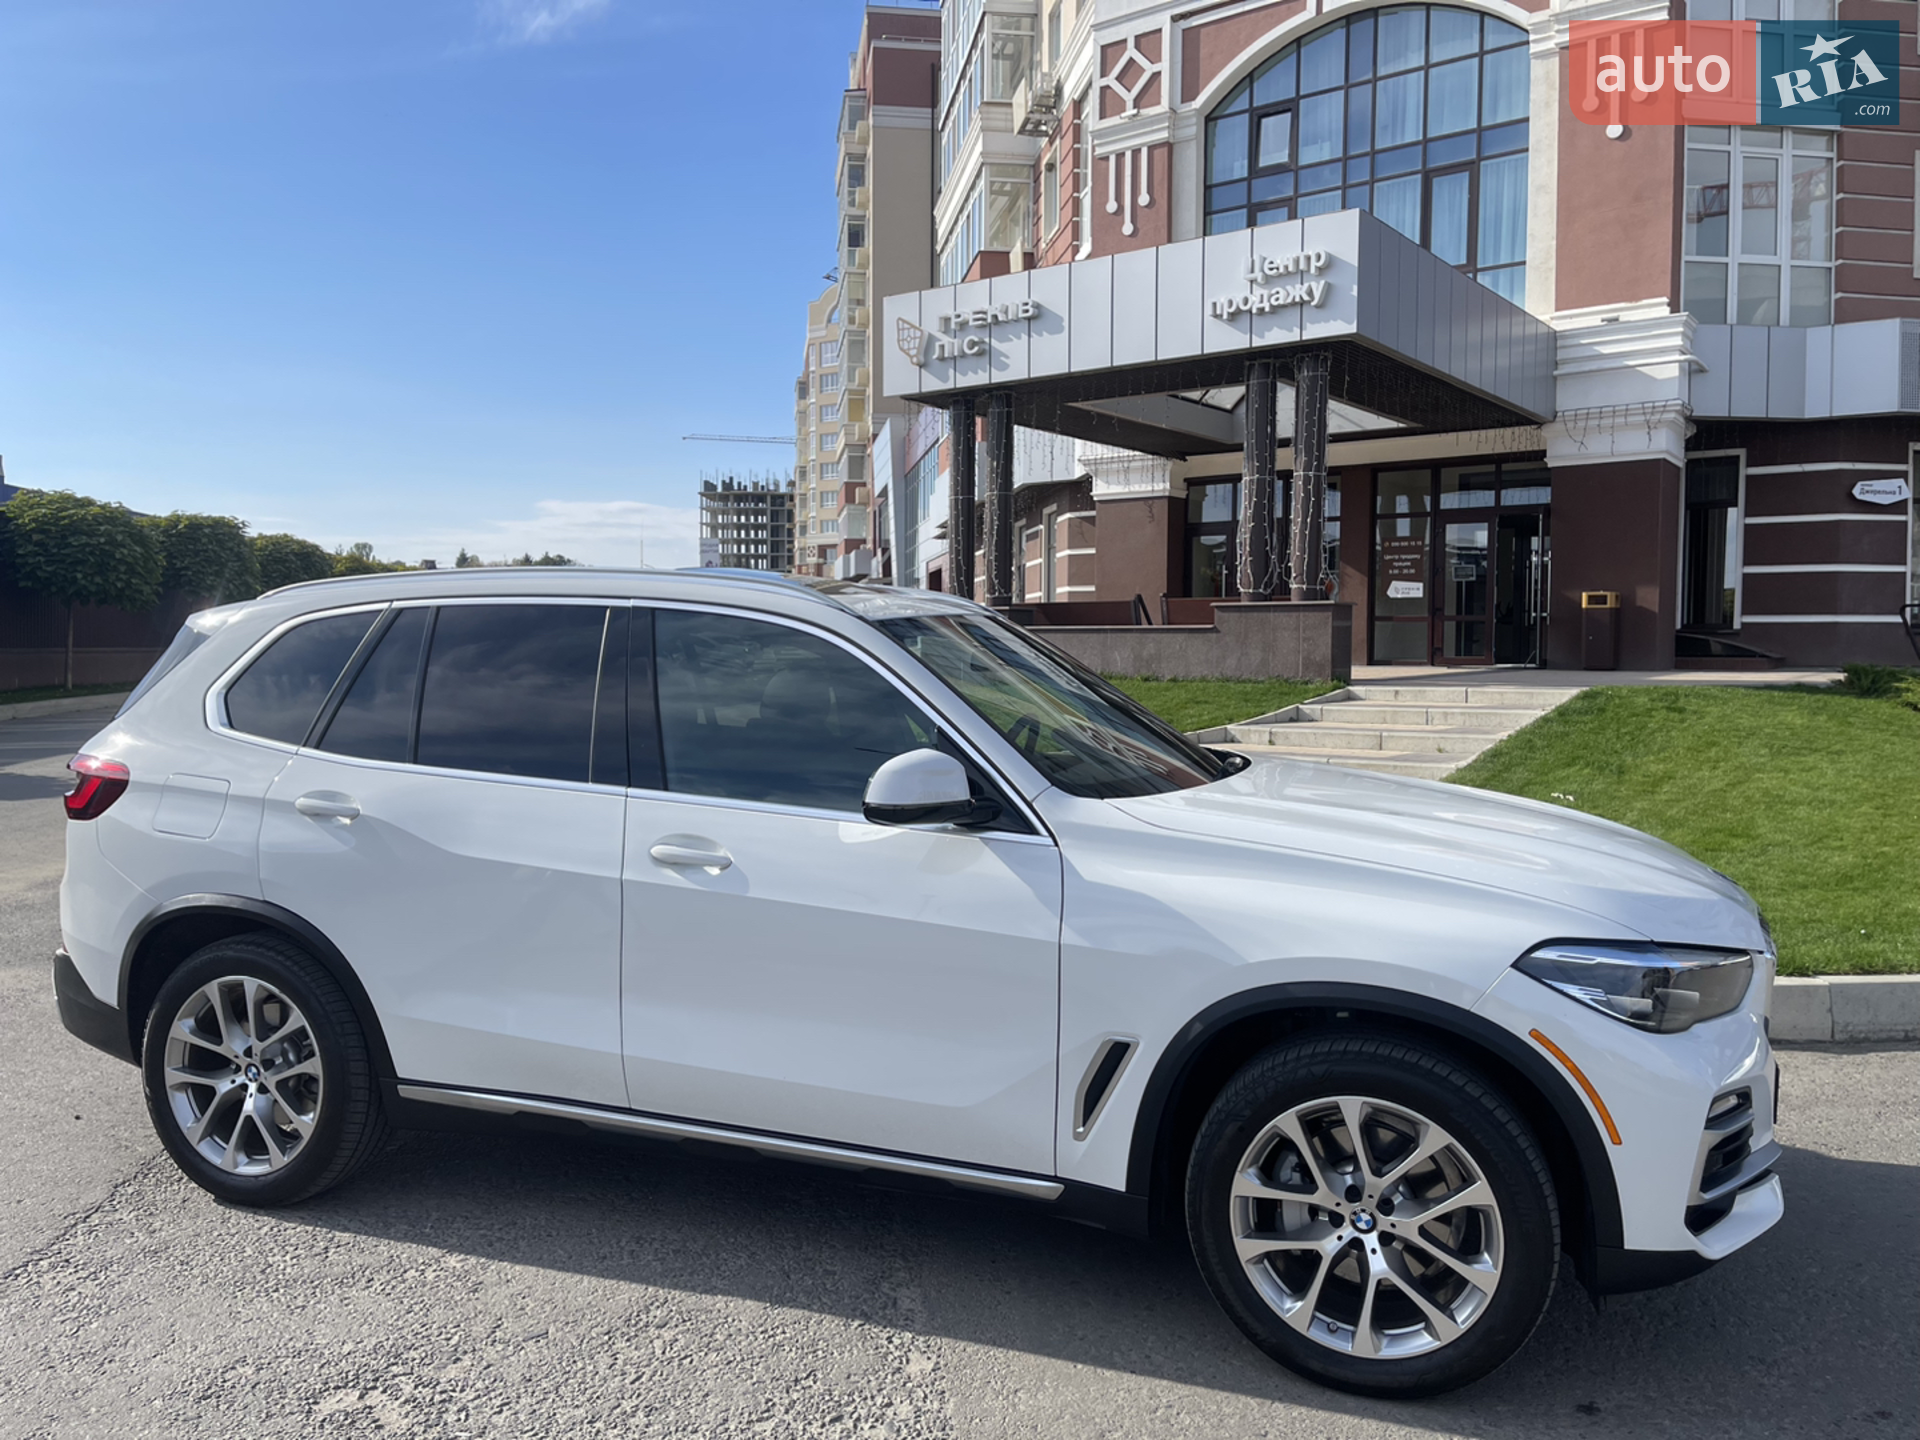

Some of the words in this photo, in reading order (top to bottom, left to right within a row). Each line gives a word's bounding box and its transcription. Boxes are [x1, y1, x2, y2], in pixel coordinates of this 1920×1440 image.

[1241, 248, 1329, 284] Центр
[1209, 280, 1329, 320] продажу
[932, 335, 985, 361] ЛІС
[1897, 485, 1902, 496] 1
